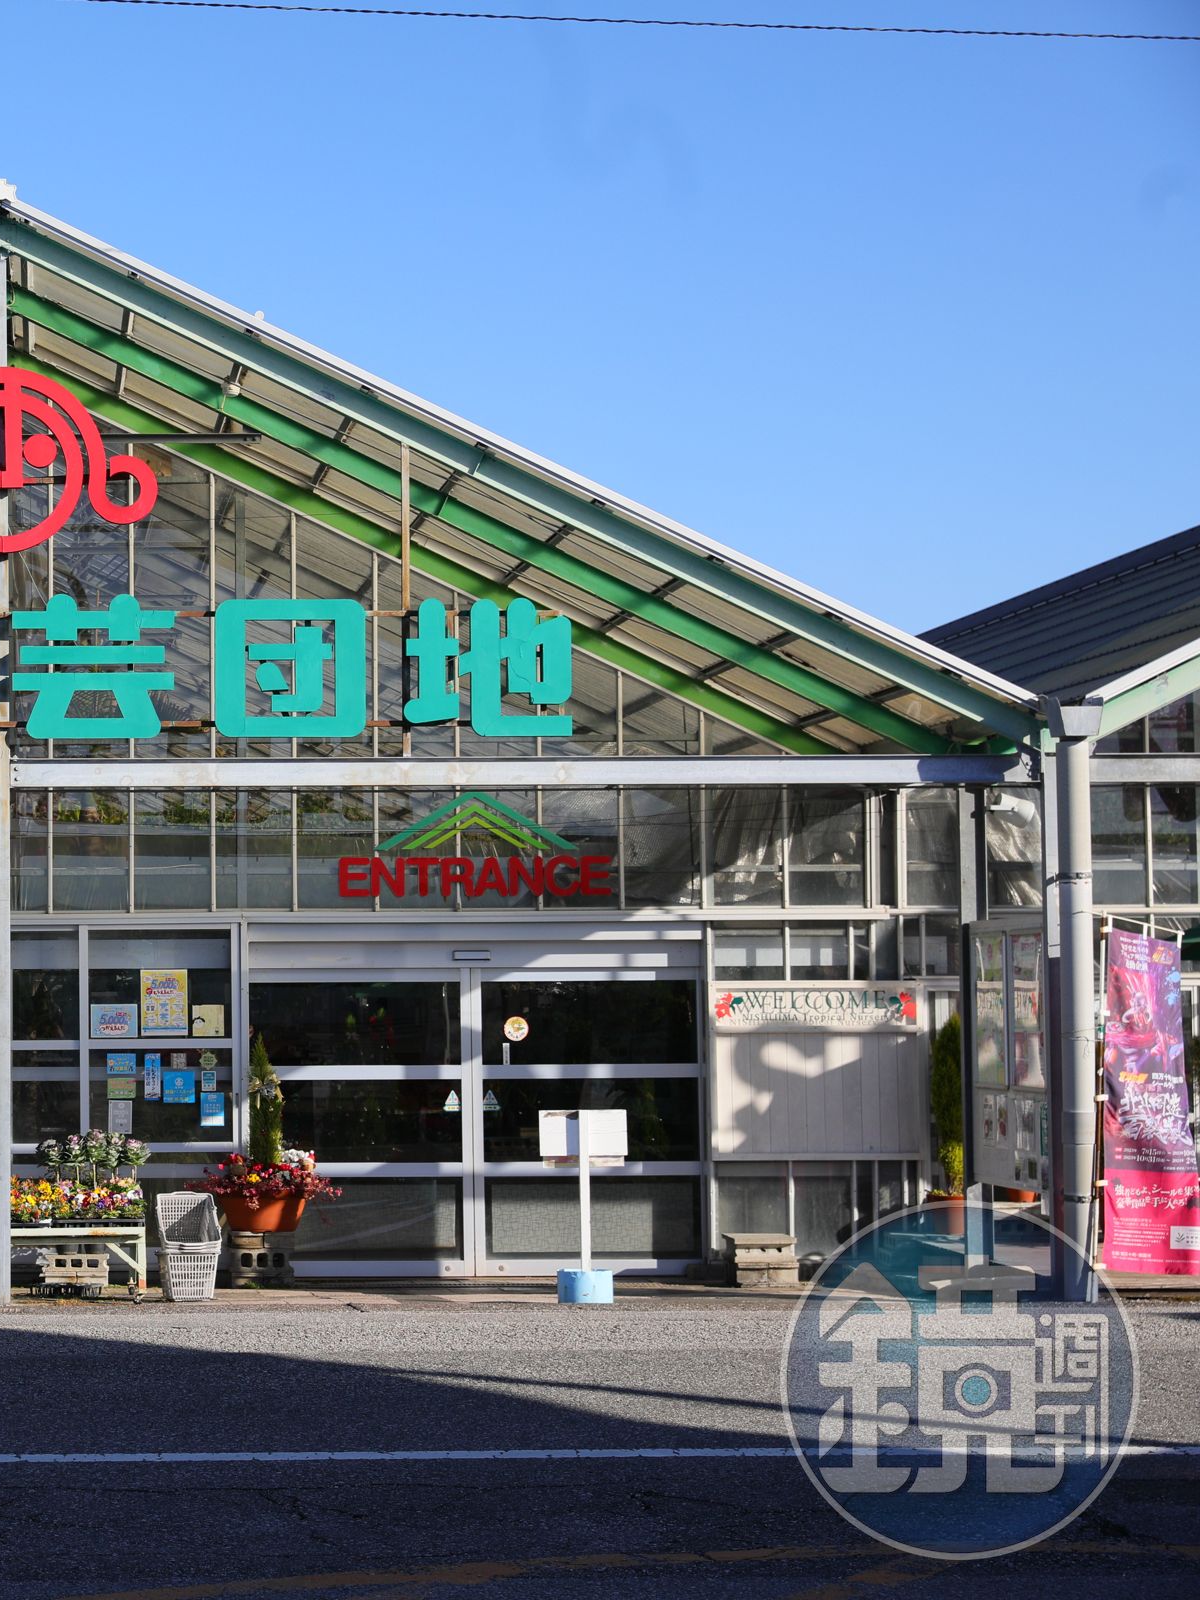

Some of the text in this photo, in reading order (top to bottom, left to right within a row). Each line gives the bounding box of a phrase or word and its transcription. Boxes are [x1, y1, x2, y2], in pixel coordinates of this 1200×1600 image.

[338, 855, 614, 898] ENTRANCE
[743, 990, 887, 1009] WELCOME
[803, 1013, 845, 1022] Tropical
